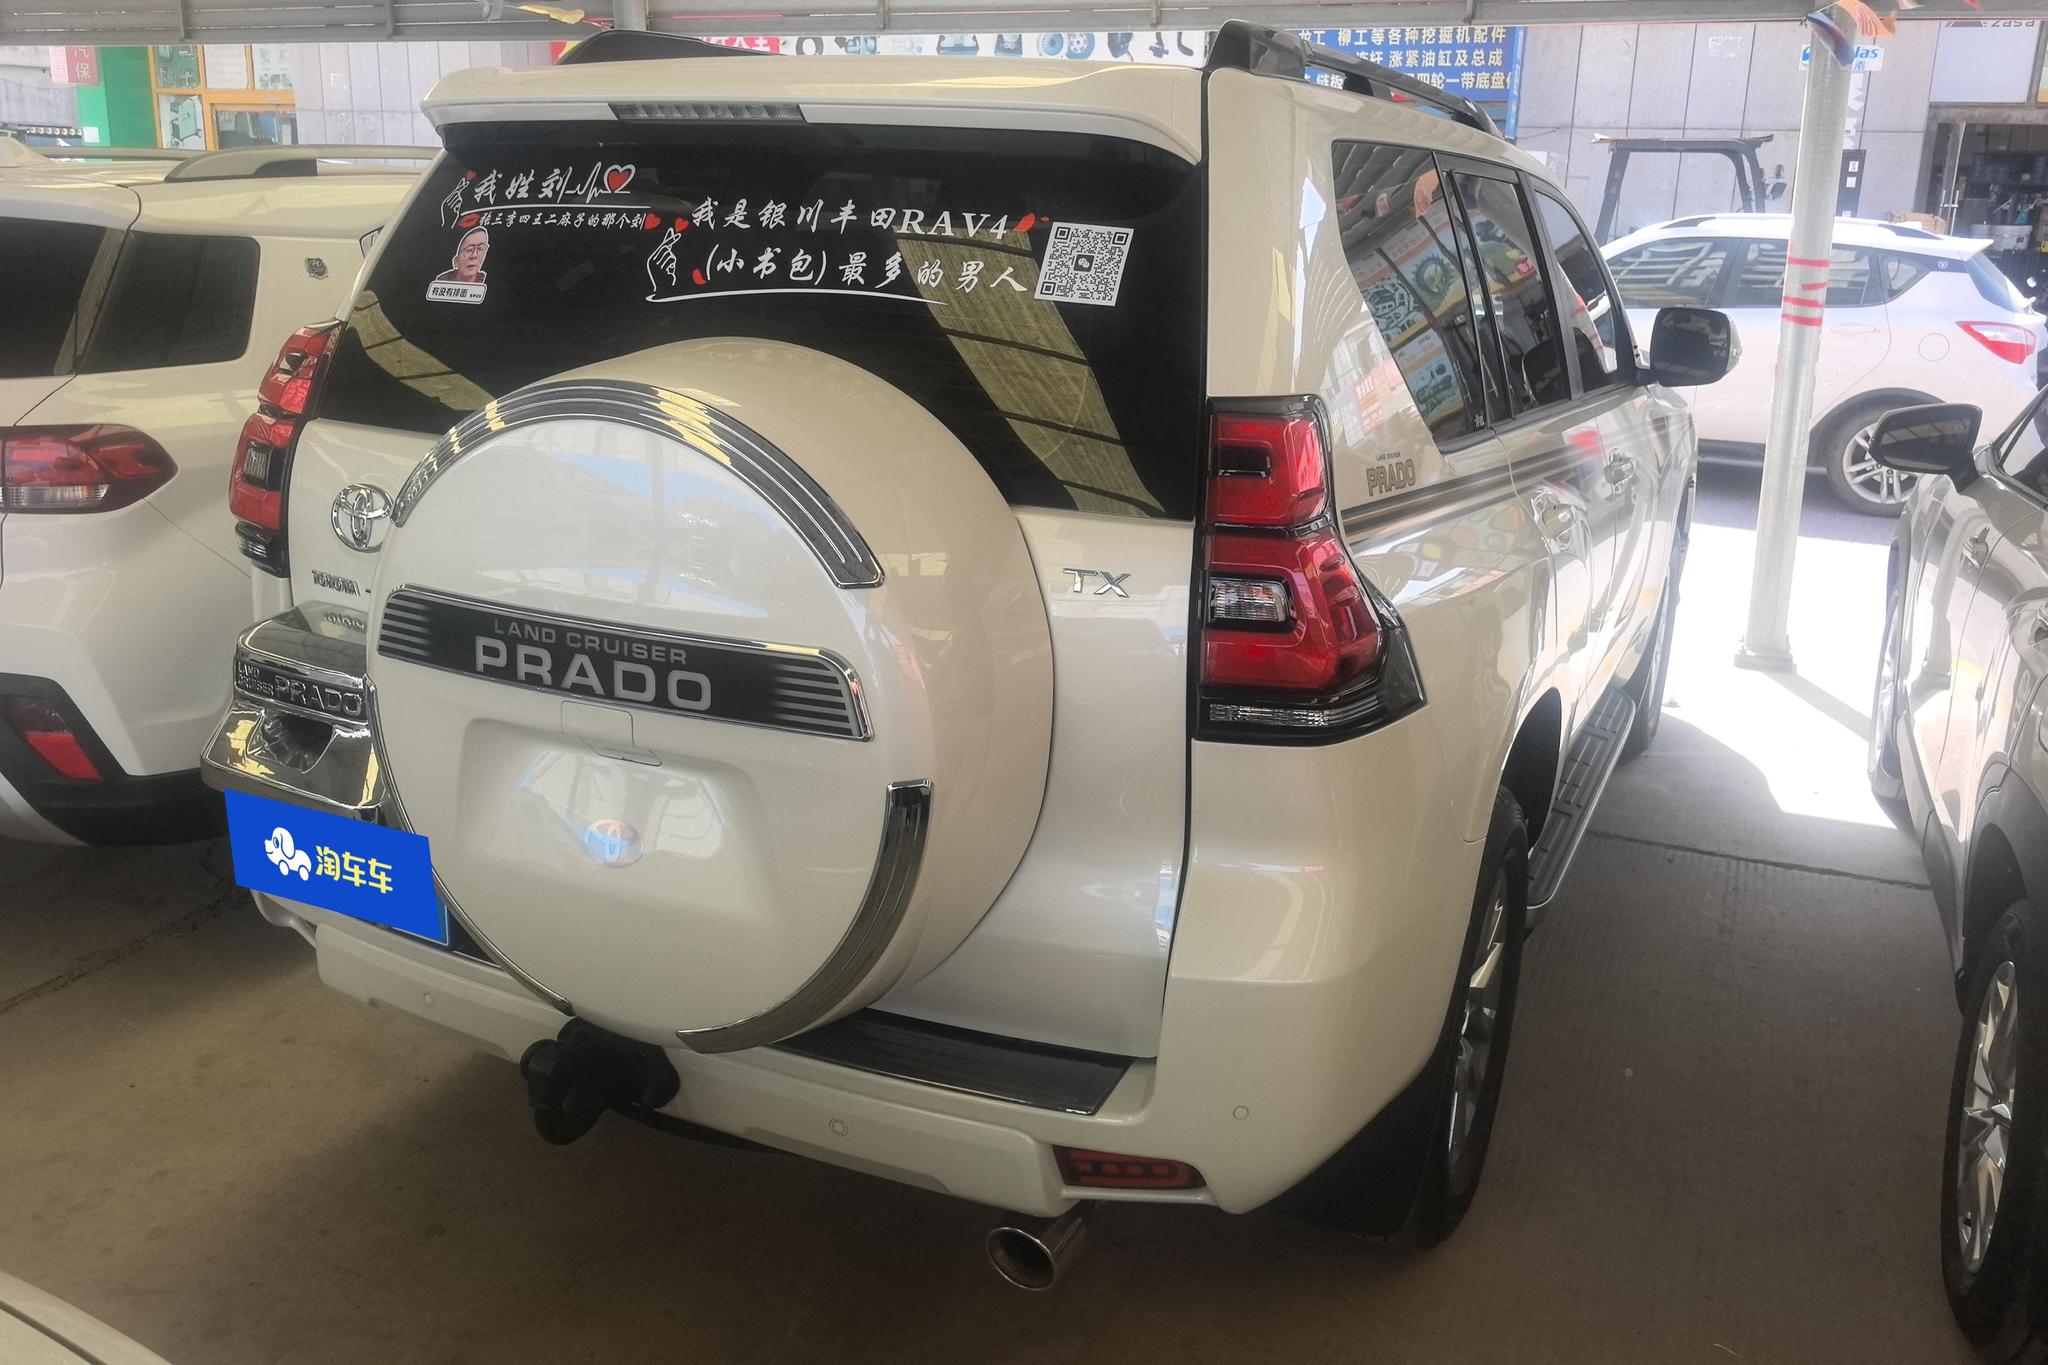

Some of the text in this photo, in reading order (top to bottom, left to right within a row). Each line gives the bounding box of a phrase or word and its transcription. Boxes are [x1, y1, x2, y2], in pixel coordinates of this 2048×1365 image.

[1366, 459, 1416, 496] PRADO
[311, 569, 361, 597] TOYOTA
[1062, 567, 1131, 598] TX
[493, 618, 687, 666] LAND CRUISER
[474, 635, 712, 712] PRADO
[274, 674, 362, 716] PRADO
